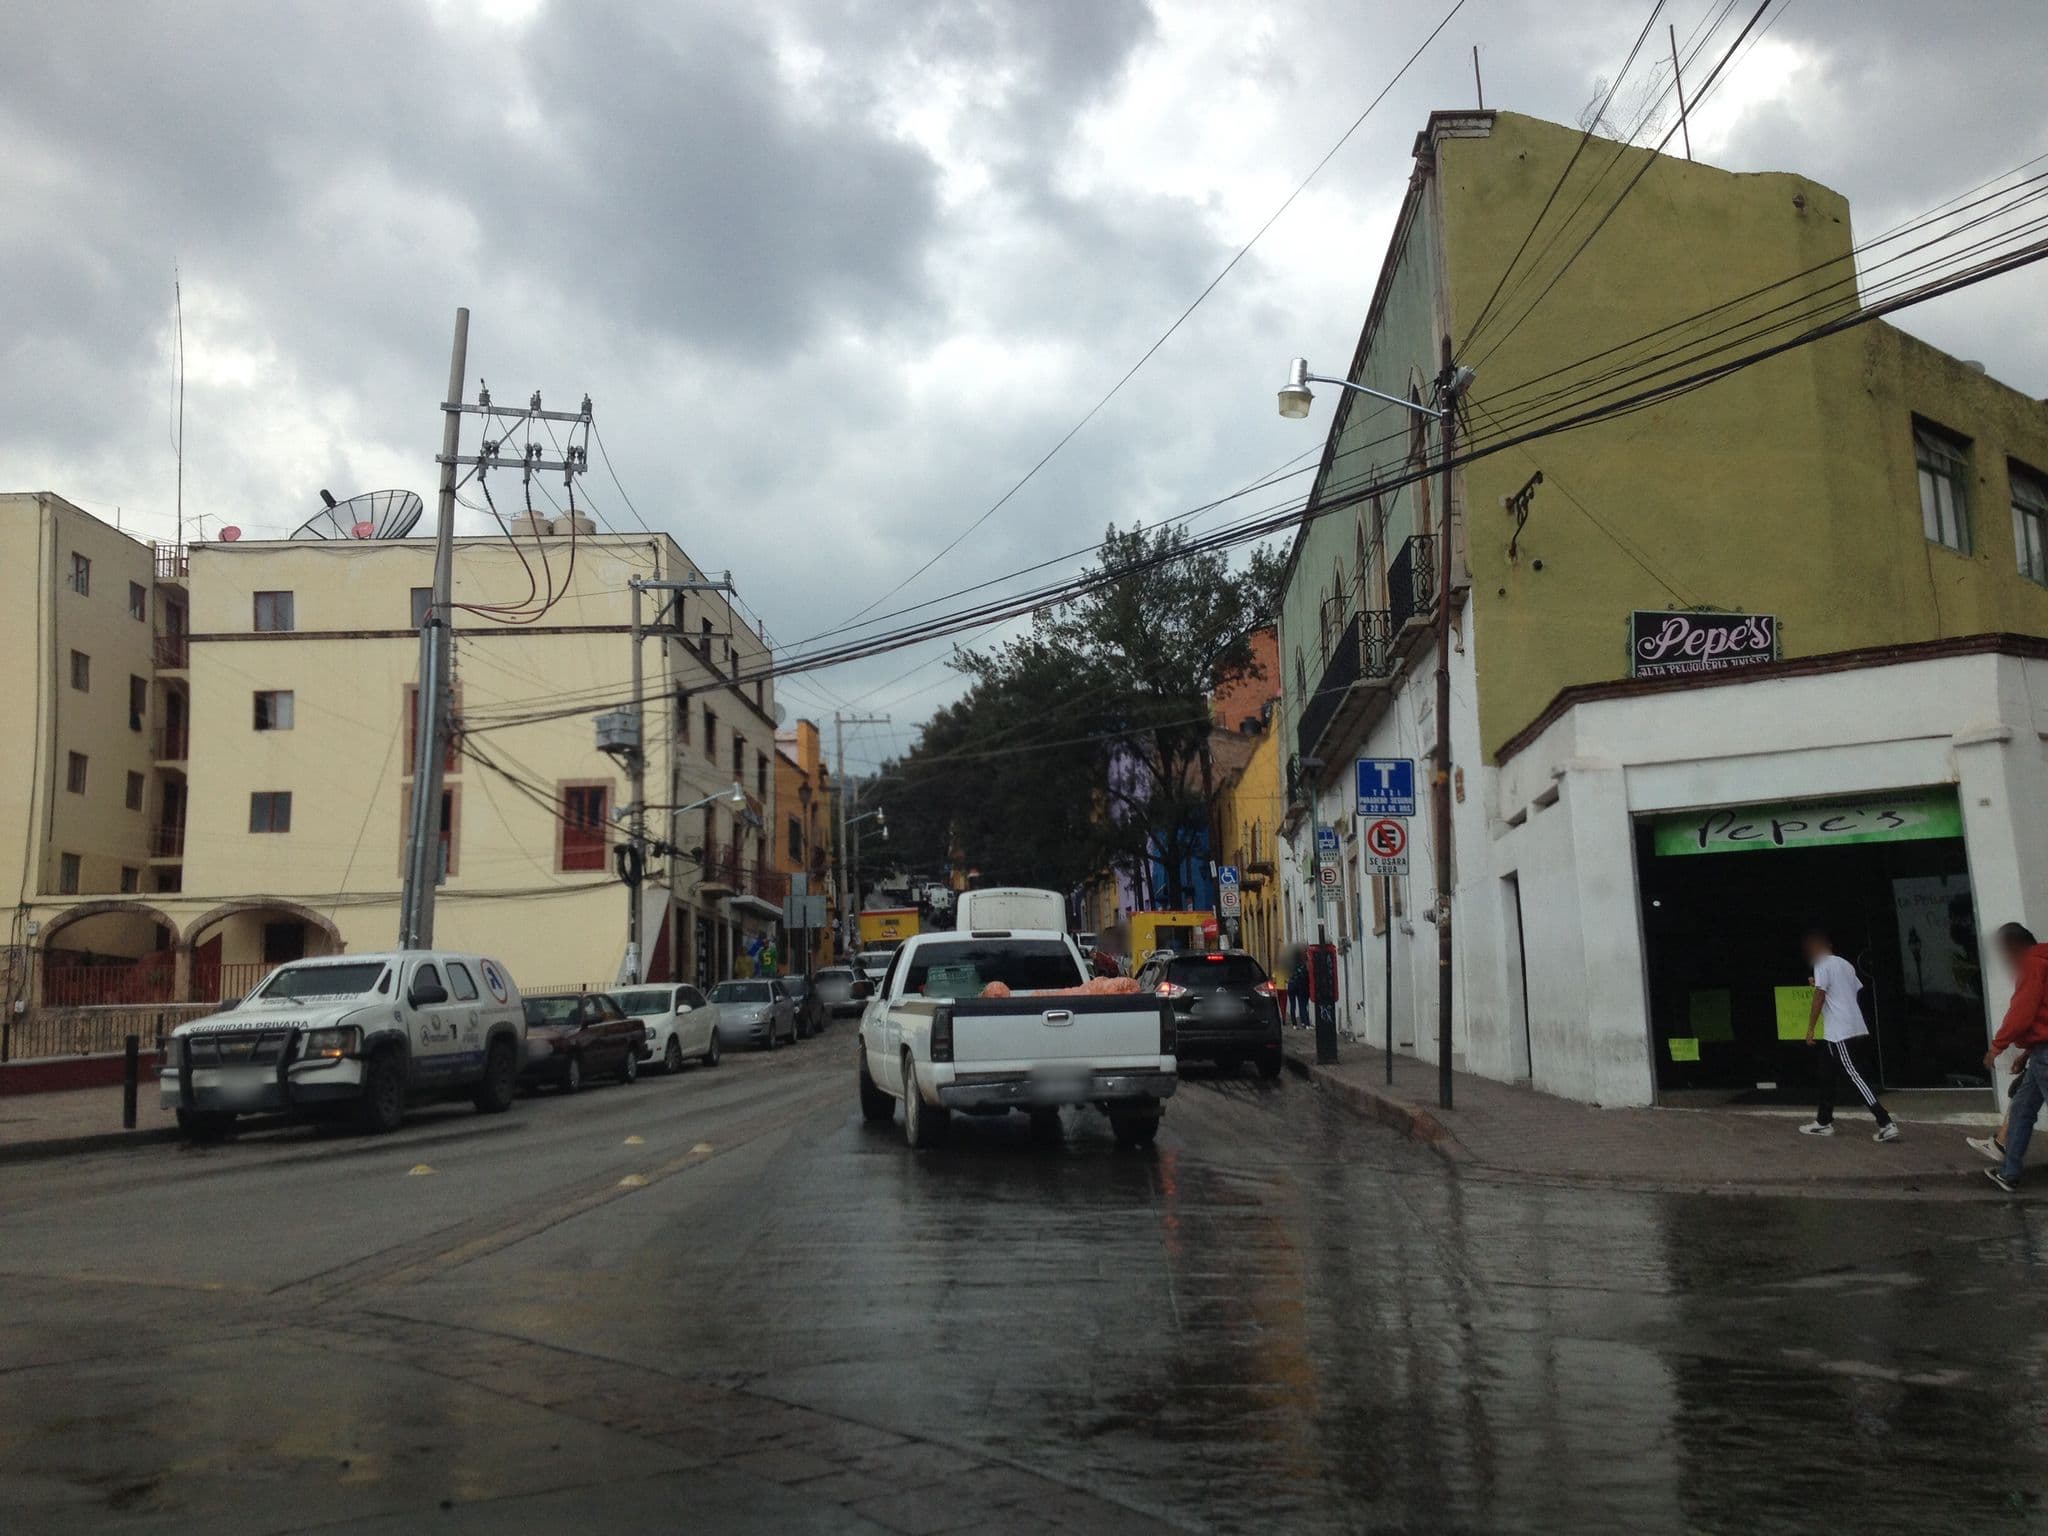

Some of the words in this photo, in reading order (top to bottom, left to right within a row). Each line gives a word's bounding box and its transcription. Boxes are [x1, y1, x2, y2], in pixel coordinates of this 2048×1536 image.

[1637, 617, 1772, 662] Pepe's
[1638, 666, 1666, 678] ALTA
[1374, 763, 1396, 789] T
[1698, 810, 1904, 848] Pepe's
